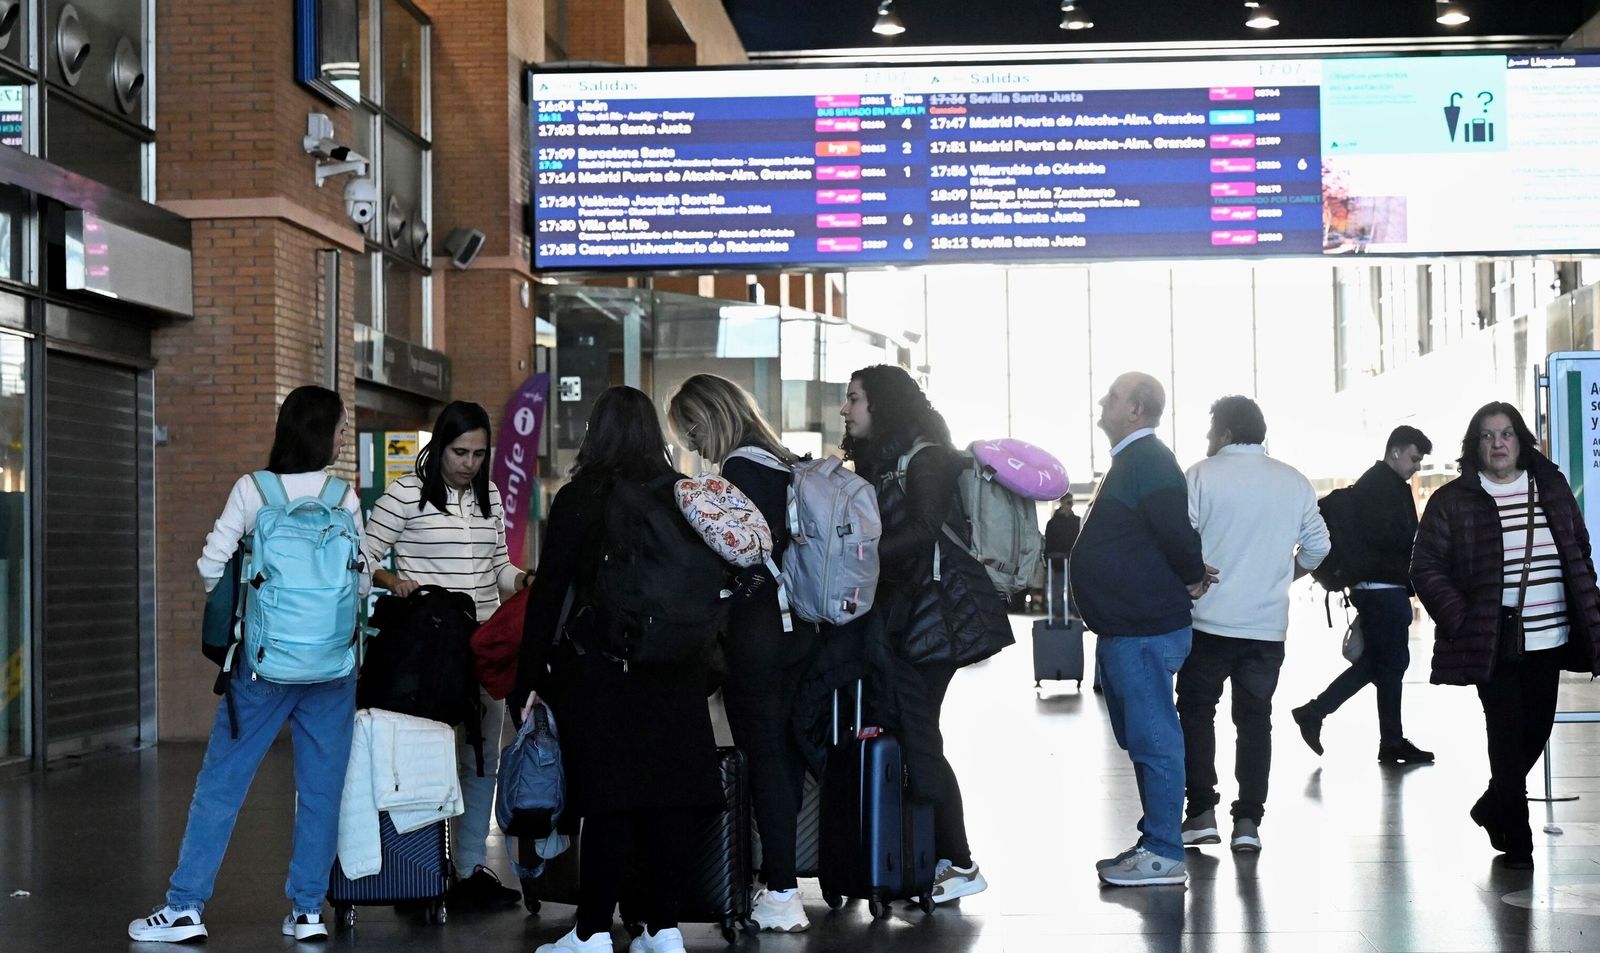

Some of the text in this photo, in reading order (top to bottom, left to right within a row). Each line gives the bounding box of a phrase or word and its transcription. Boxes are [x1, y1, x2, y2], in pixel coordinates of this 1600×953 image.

[1531, 57, 1576, 68] Llegadas
[970, 72, 1030, 84] Salidas
[579, 79, 638, 92] Salidas
[970, 94, 1009, 103] Sevilla
[1013, 93, 1046, 103] Santa
[1050, 93, 1082, 102] Justa
[539, 101, 574, 112] 16:04
[872, 107, 884, 116] EN
[901, 118, 912, 130] 4
[931, 117, 966, 129] 17:47
[970, 116, 1012, 128] Madrid
[1014, 116, 1054, 127] Puerta
[1056, 115, 1073, 126] de
[1154, 113, 1205, 126] Grandes
[539, 123, 691, 136] 17:03 Sevilla Santa Justa
[902, 142, 912, 154] 2
[970, 140, 1012, 152] Madrid
[1015, 140, 1055, 152] Puerta
[1057, 139, 1073, 150] de
[1154, 137, 1205, 150] Grandes
[539, 148, 575, 160] 17:09
[578, 147, 638, 159] Barcelona
[1034, 164, 1050, 174] de
[1052, 163, 1105, 174] Córdoba
[1298, 158, 1307, 170] 6
[539, 172, 575, 184] 17:14
[578, 171, 621, 183] Madrid
[623, 171, 662, 182] Puerta
[664, 170, 680, 182] de
[760, 168, 811, 180] Grandes
[904, 166, 910, 178] 1
[931, 187, 1116, 201] 18:09 Málaga María Zambrano
[539, 196, 576, 208] 17:24
[903, 214, 913, 226] 6
[932, 212, 1085, 225] 18:12 Sevilla Santa Justa
[540, 218, 649, 232] 17:30 Villa del Río
[903, 238, 913, 250] 6
[932, 235, 1086, 249] 18:12 Sevilla Santa Justa
[579, 244, 629, 257] Campus
[630, 242, 707, 255] Universitario
[708, 242, 725, 252] de
[727, 241, 789, 252] Rabanales
[1591, 416, 1598, 430] y
[504, 443, 526, 529] renfe
